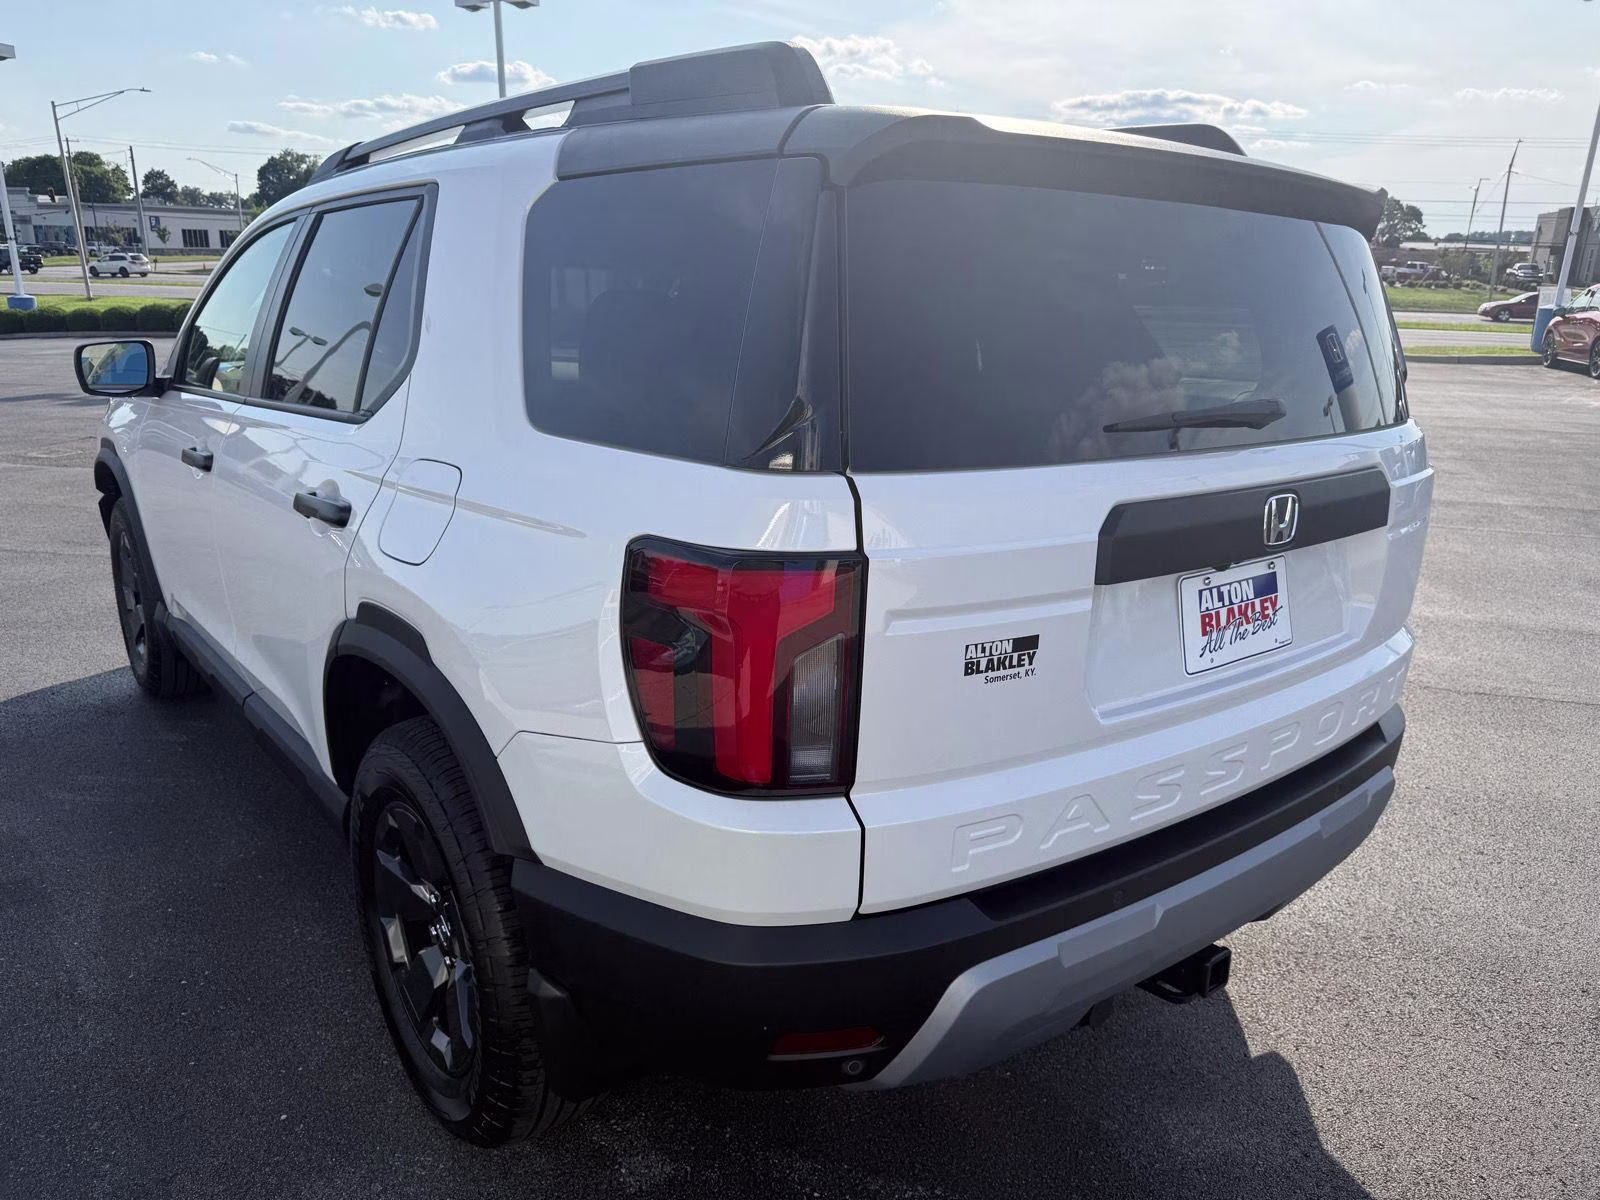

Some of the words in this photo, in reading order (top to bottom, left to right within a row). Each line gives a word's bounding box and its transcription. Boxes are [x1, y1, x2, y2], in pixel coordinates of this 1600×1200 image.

[1200, 578, 1255, 612] ALTON
[1199, 624, 1228, 658] All
[1226, 616, 1250, 645] The
[1250, 605, 1283, 635] Best
[1200, 594, 1279, 638] BLAKLEY
[963, 651, 1037, 677] BLAKLEY
[965, 639, 1014, 660] ALTON
[983, 671, 1022, 685] Somerset,
[1024, 667, 1037, 678] KY.
[951, 663, 1406, 873] PASSPORT
